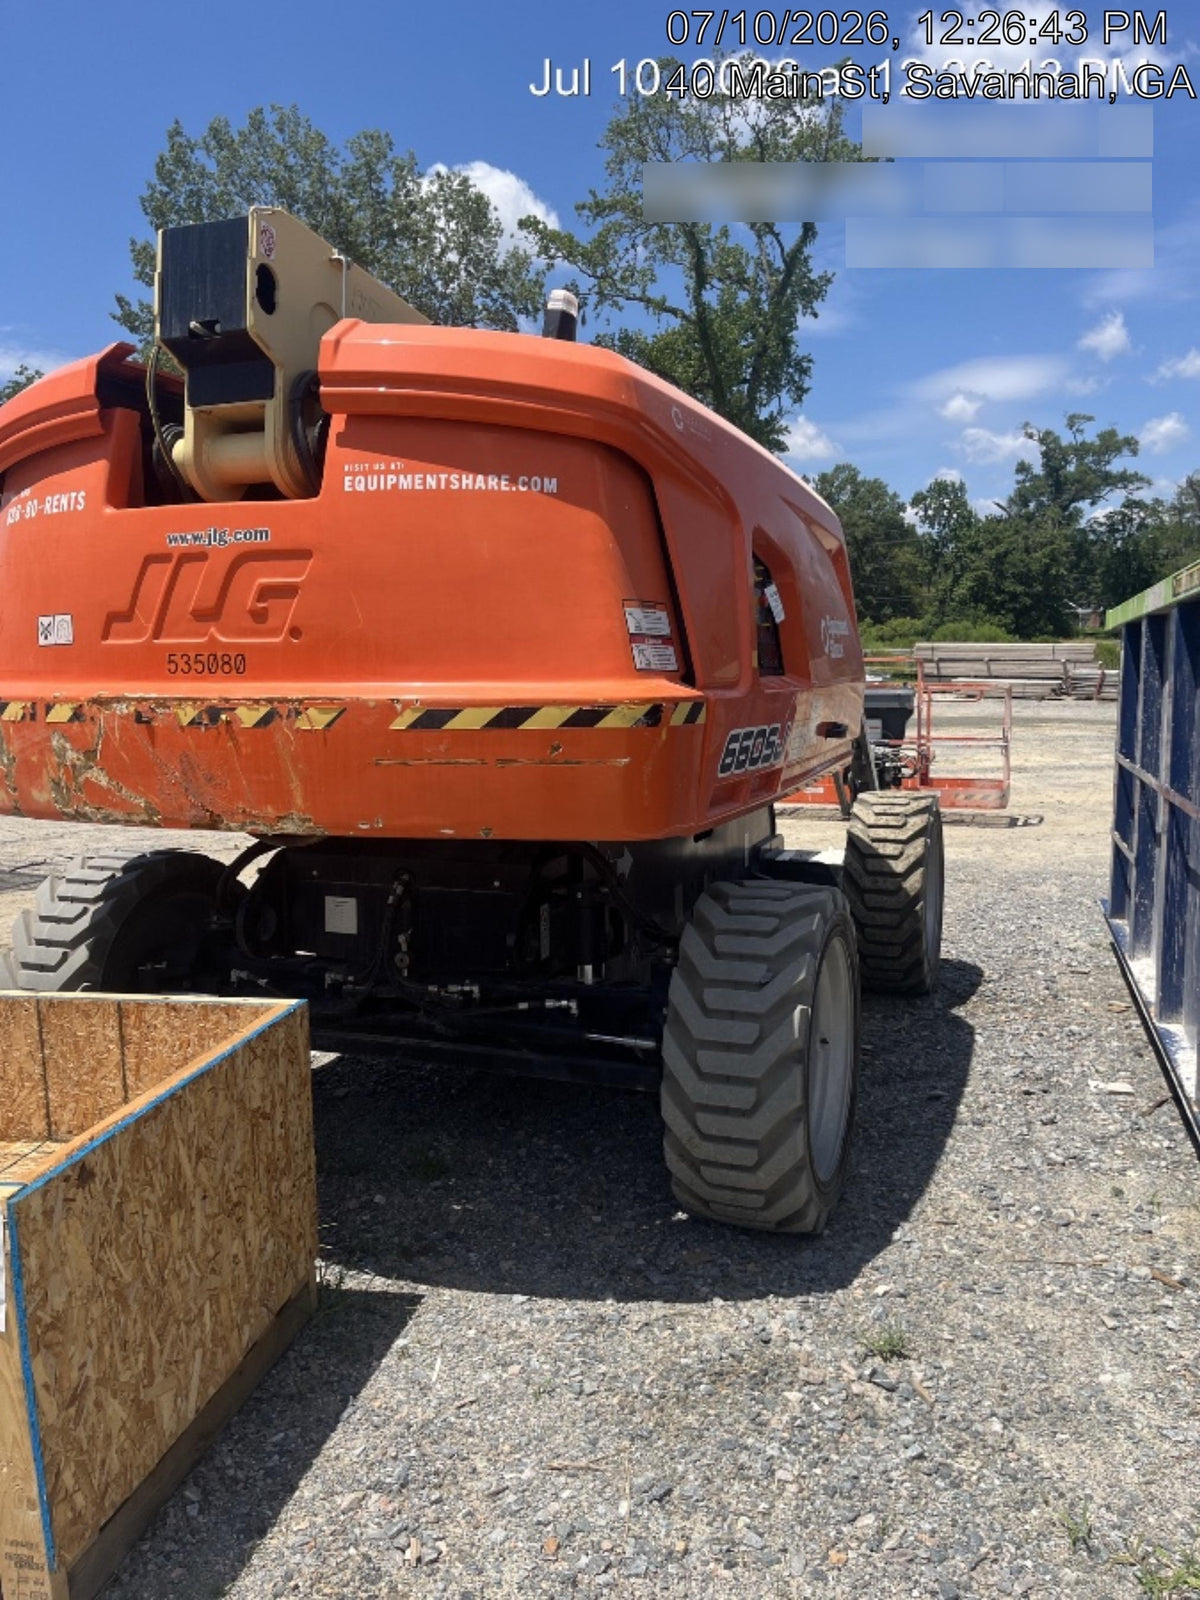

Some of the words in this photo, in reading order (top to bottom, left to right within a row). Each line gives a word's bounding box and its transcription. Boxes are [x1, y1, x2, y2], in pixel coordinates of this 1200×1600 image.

[344, 473, 558, 493] EQUIPMENTSHARE.COM
[166, 527, 271, 547] www.jlg.com
[167, 653, 246, 675] 535080
